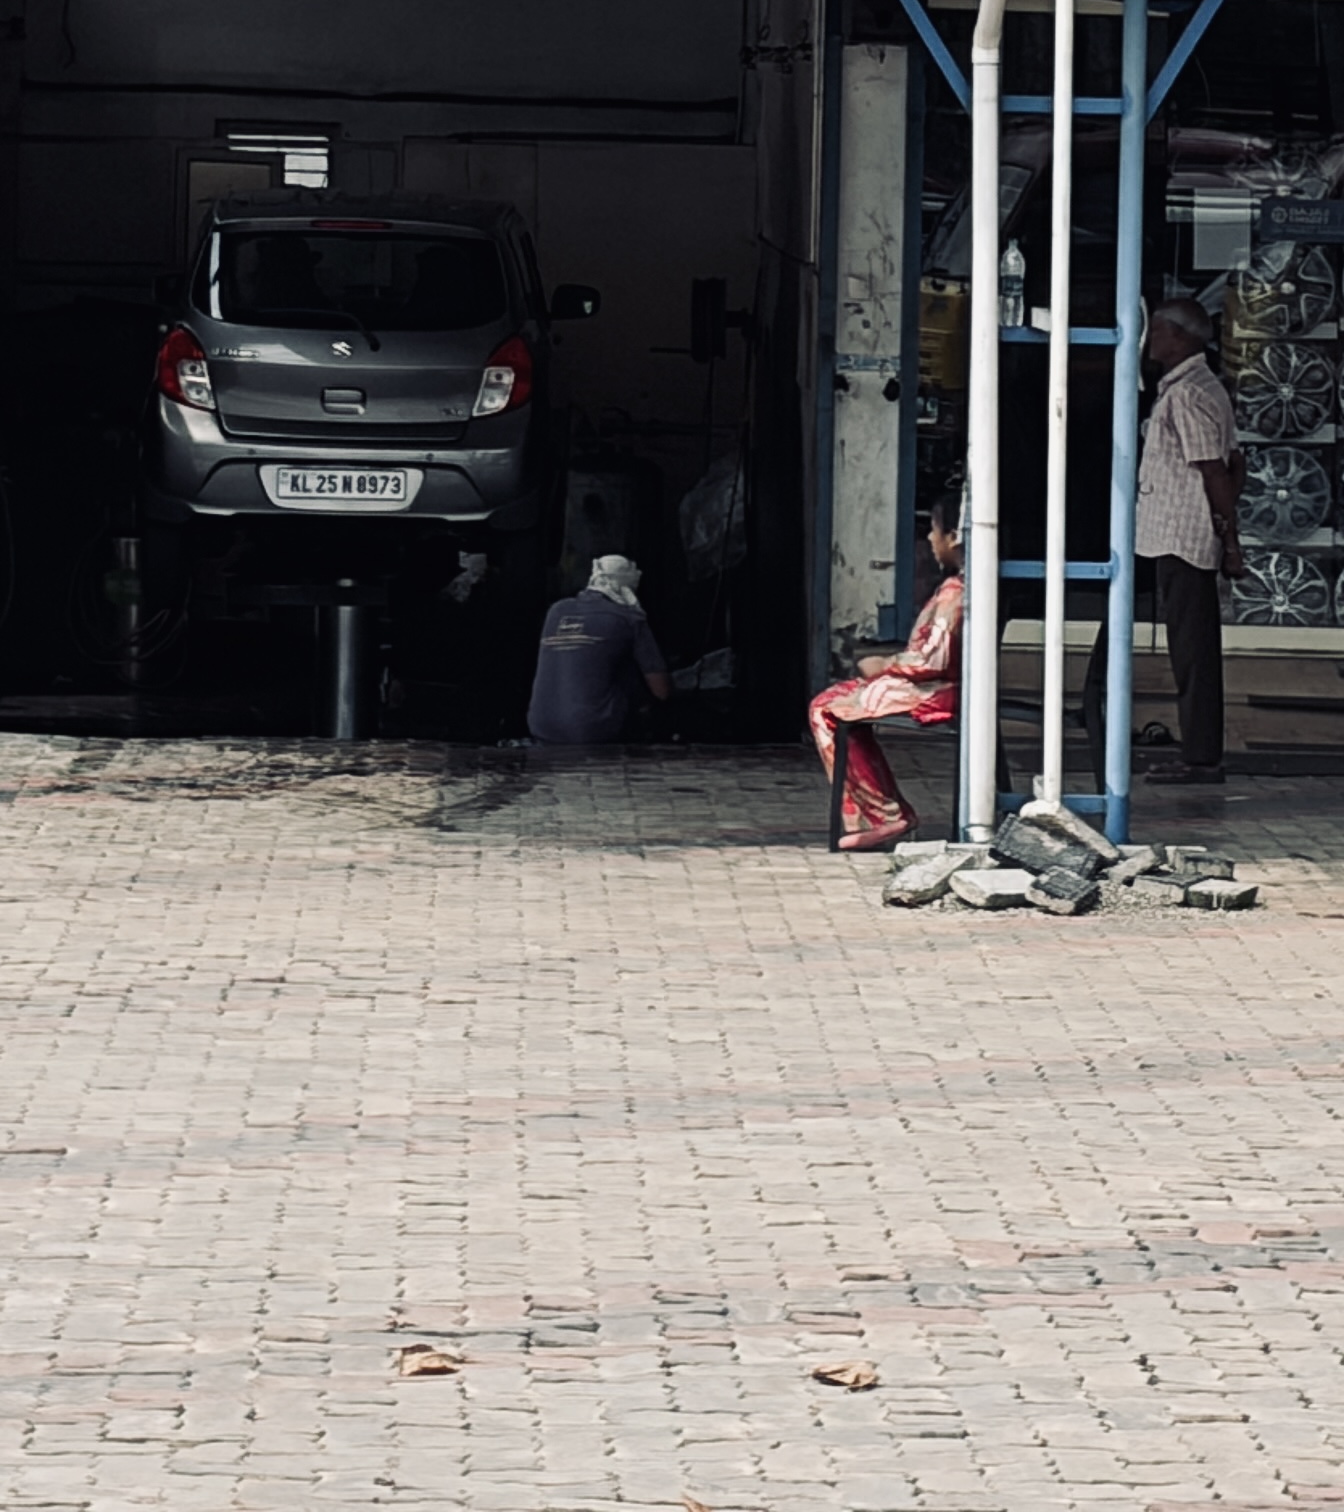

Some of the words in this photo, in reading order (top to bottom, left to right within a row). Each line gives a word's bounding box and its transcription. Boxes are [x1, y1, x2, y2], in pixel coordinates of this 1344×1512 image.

[290, 474, 312, 494] KL
[316, 475, 337, 494] 25
[357, 476, 401, 496] 8973
